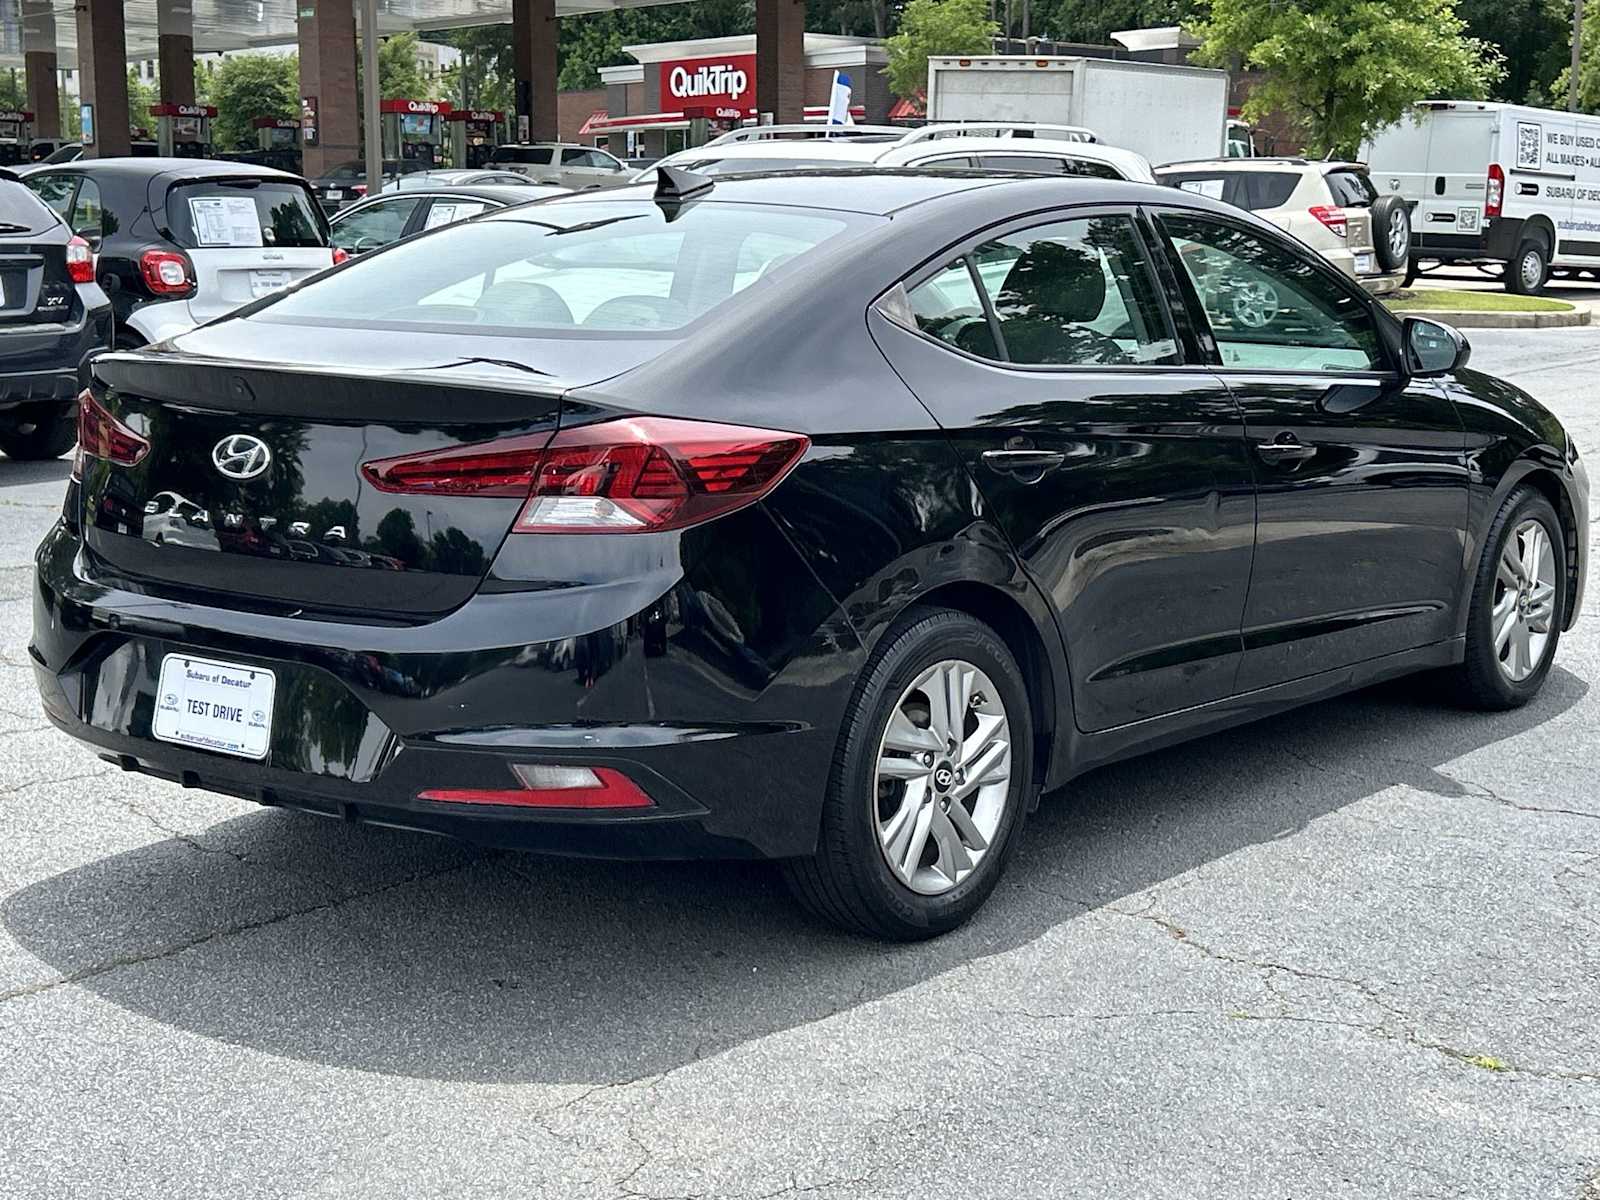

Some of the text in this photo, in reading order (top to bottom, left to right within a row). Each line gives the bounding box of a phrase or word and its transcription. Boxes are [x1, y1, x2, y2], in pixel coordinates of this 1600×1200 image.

[669, 64, 747, 100] QuikTrip
[407, 101, 439, 114] QuikTrip
[1547, 133, 1558, 144] WE
[1560, 134, 1574, 146] BUY
[1575, 136, 1595, 148] USED
[1546, 152, 1559, 164] ALL
[1560, 153, 1585, 167] MAKES
[1546, 186, 1576, 200] SUBARU
[1576, 188, 1587, 200] OF
[144, 501, 346, 540] ELANTRA
[186, 669, 252, 688] Subaru of Decatur
[187, 699, 243, 723] TEST DRIVE
